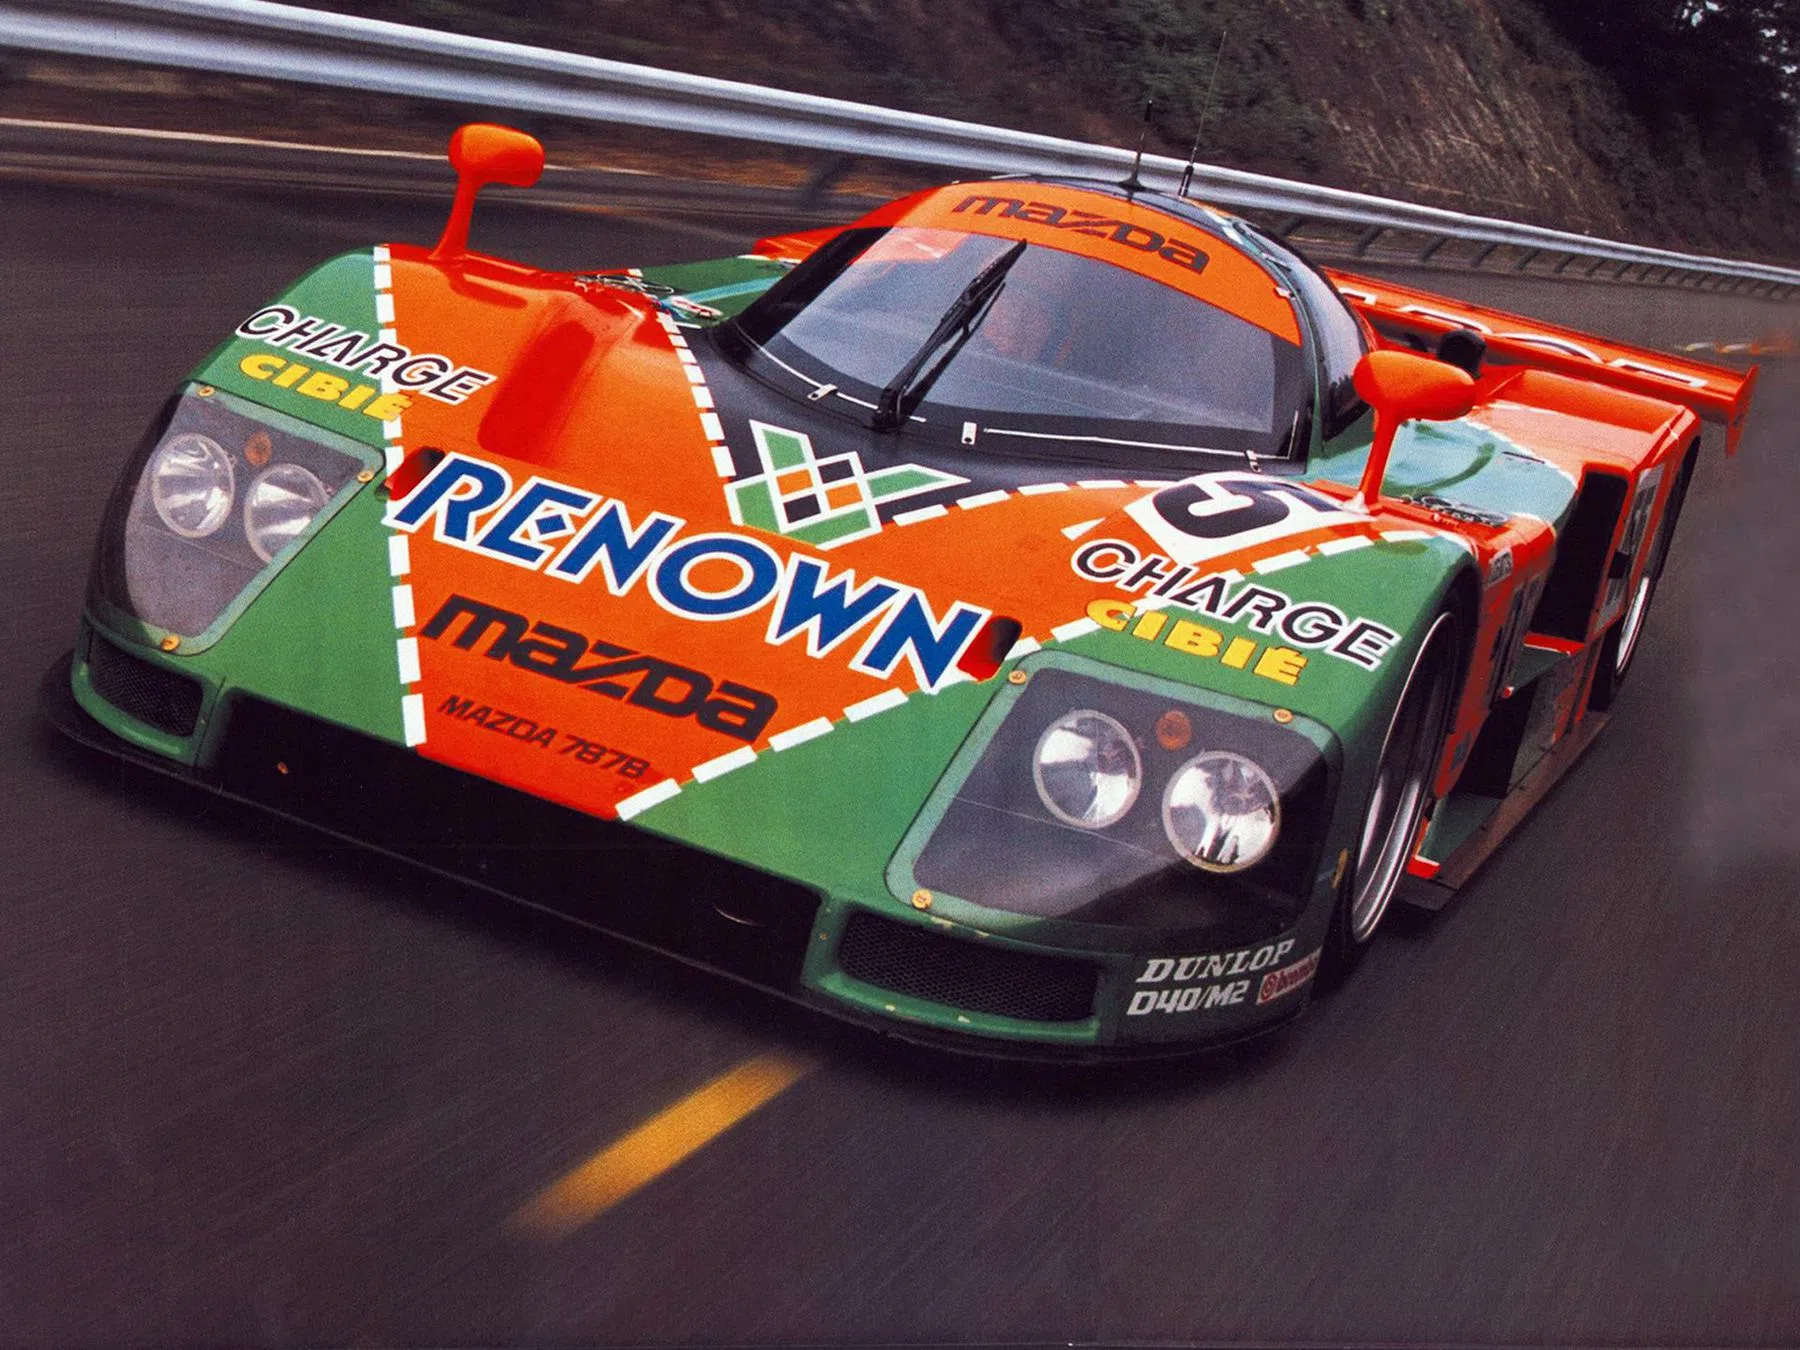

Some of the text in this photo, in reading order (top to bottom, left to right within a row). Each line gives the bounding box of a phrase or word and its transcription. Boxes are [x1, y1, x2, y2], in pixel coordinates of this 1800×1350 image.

[237, 307, 496, 405] CHARGE
[1152, 480, 1342, 539] 5
[382, 451, 992, 694] RENOWN
[1071, 539, 1401, 671] CHARGE
[437, 695, 650, 778] MAZDA 787B
[1126, 981, 1250, 1016] D40/M2
[1135, 939, 1295, 983] DUNLOP
